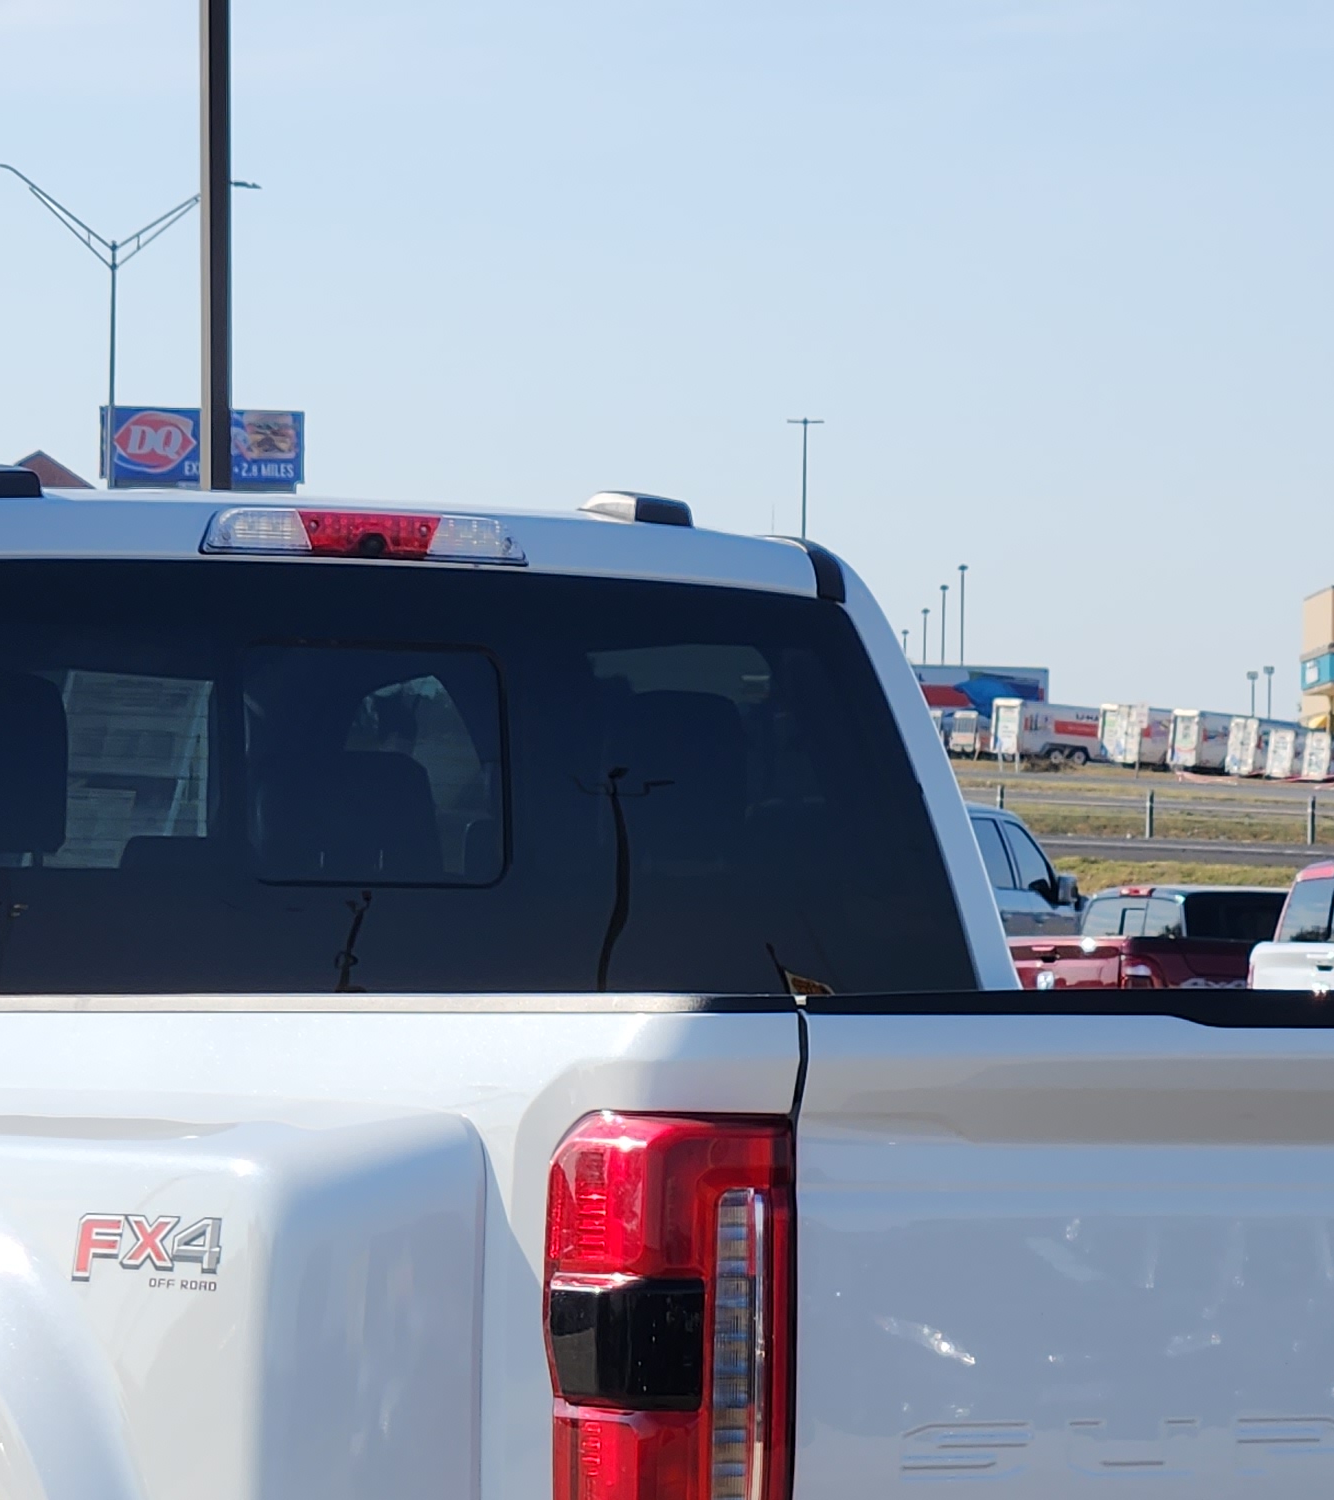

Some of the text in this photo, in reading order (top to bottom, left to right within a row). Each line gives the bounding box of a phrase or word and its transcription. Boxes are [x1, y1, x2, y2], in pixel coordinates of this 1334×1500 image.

[127, 426, 182, 461] DQ
[261, 463, 294, 478] MILES
[71, 1212, 222, 1282] FX4
[149, 1278, 217, 1292] OFF ROAD
